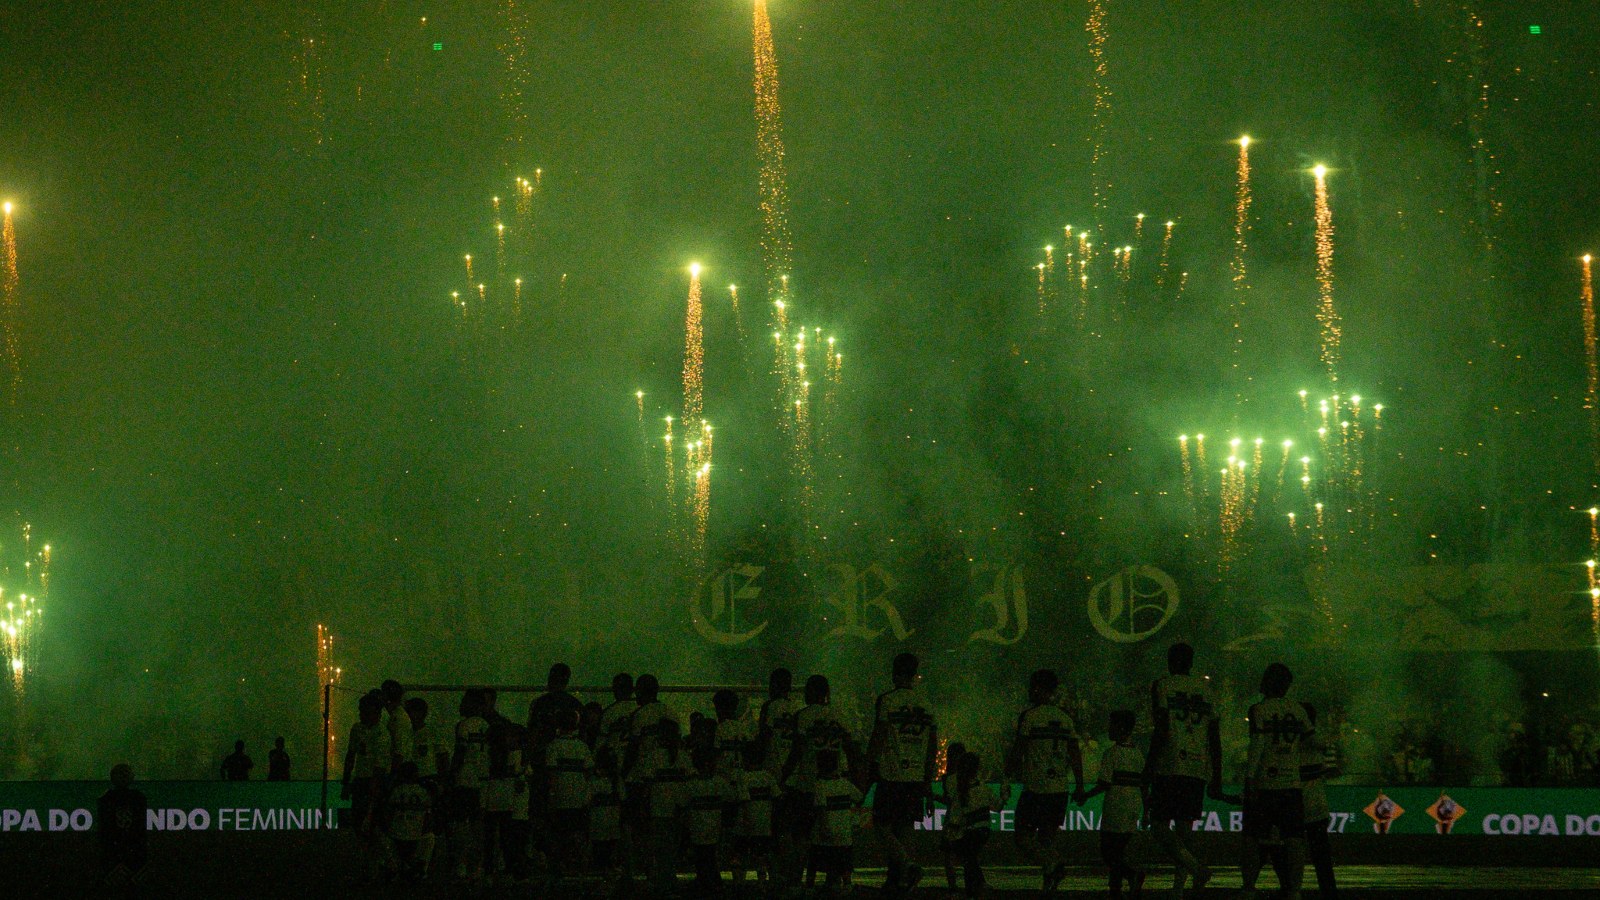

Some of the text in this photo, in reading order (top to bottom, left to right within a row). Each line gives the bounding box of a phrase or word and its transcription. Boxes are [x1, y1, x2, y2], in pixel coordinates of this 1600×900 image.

[0, 808, 339, 832] PA DO NDO FEMININ
[1482, 813, 1600, 836] COPA DO
